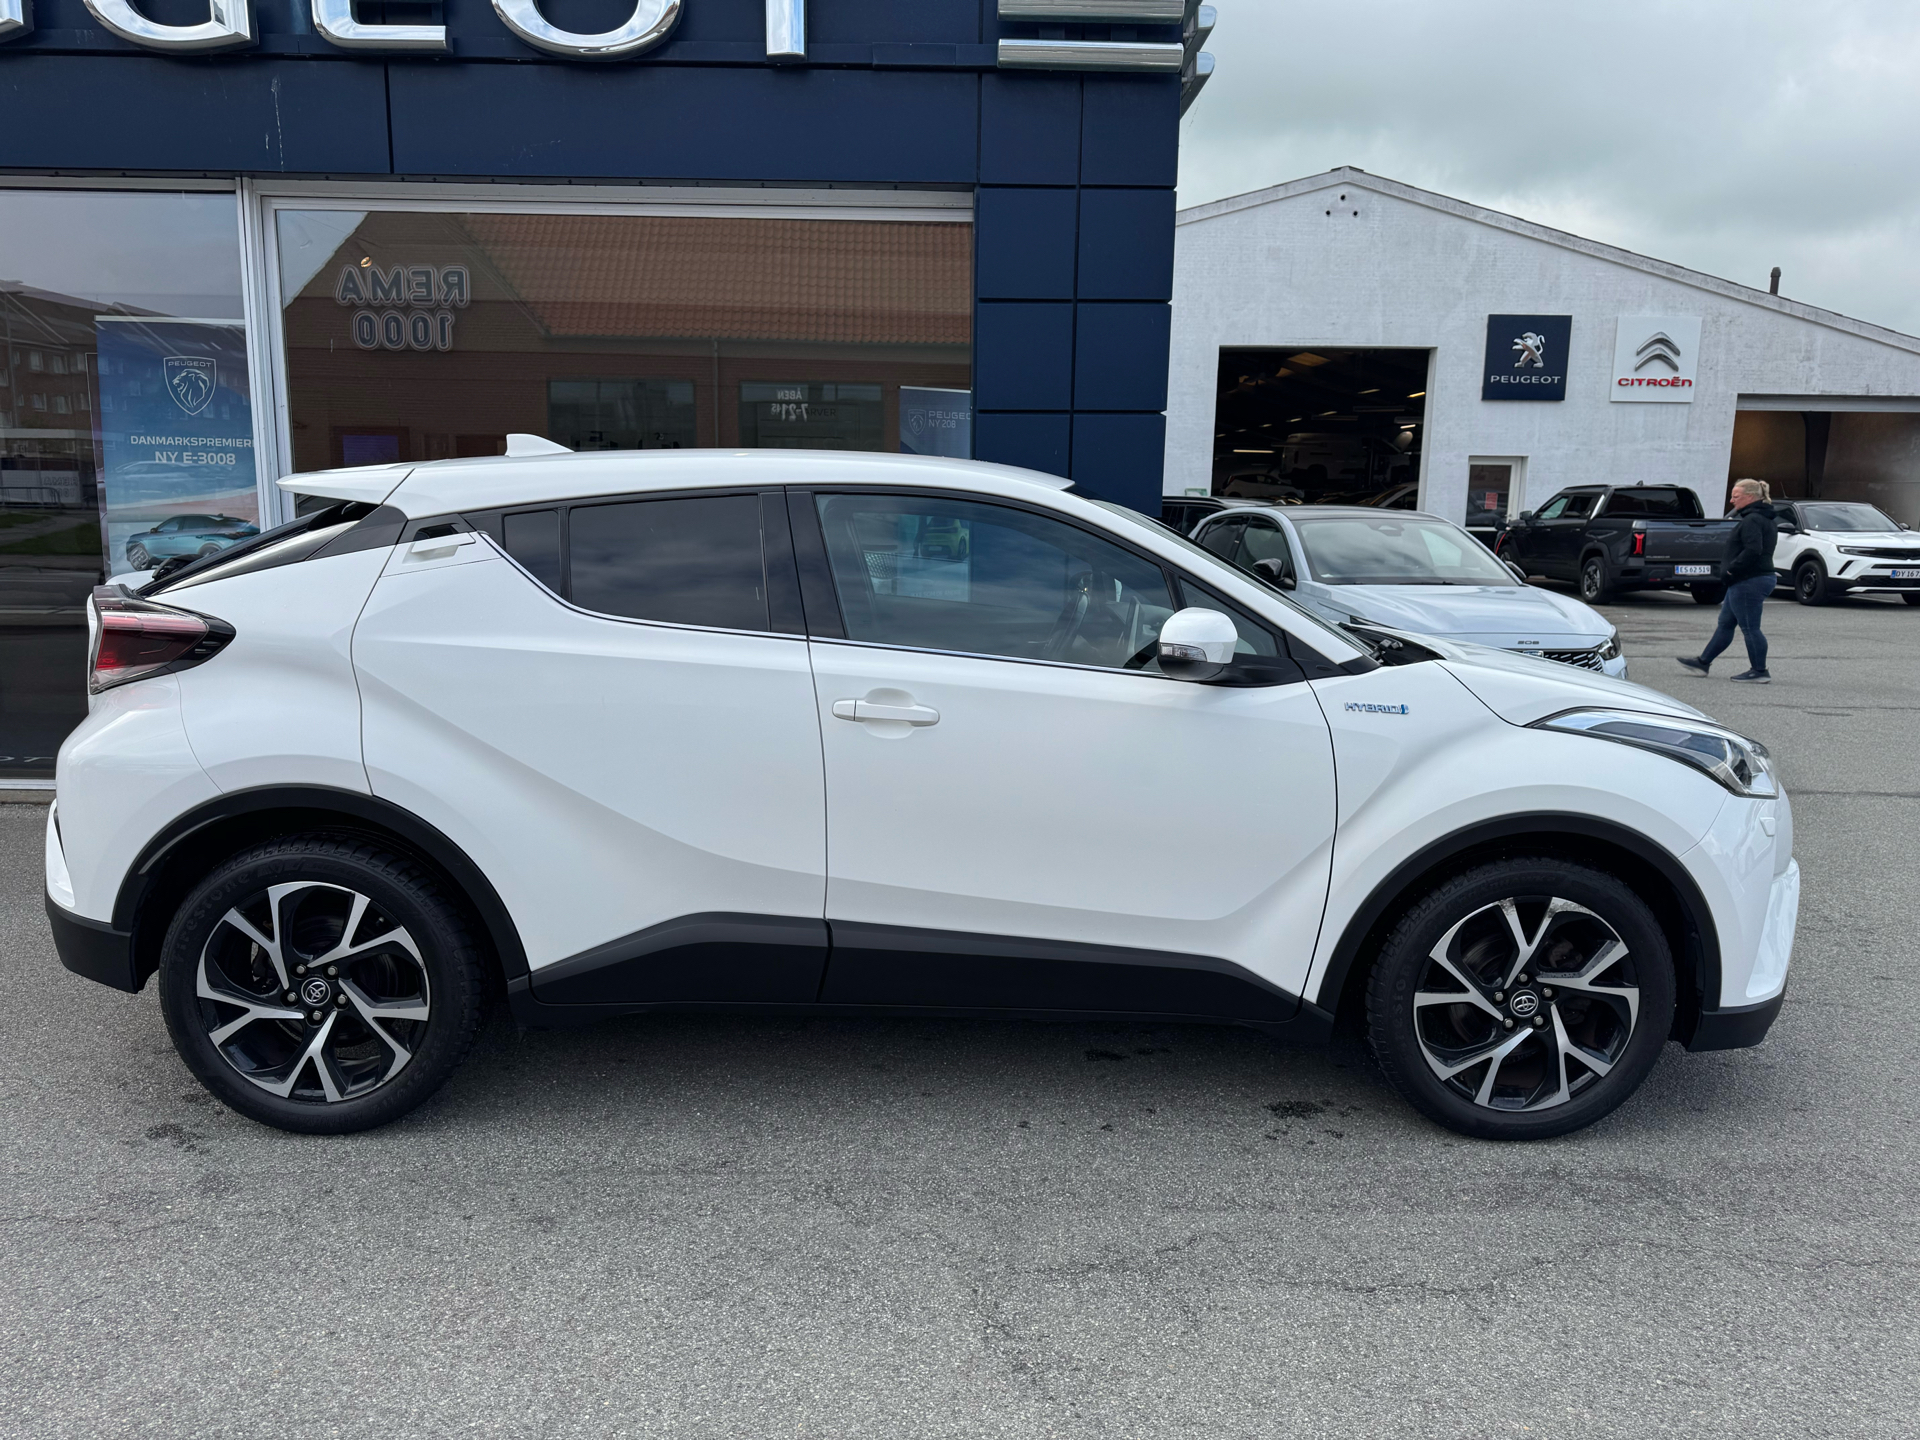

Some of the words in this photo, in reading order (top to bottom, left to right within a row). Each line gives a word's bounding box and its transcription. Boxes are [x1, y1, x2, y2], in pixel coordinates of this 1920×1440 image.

[168, 360, 212, 368] PEUGEOT
[1490, 375, 1561, 384] PEUGEOT
[928, 419, 941, 428] NY
[942, 420, 956, 428] 208
[155, 451, 179, 463] NY
[183, 452, 236, 465] E-3008
[1680, 565, 1688, 573] ES
[1690, 565, 1698, 573] 62
[1344, 702, 1401, 714] HYBRID
